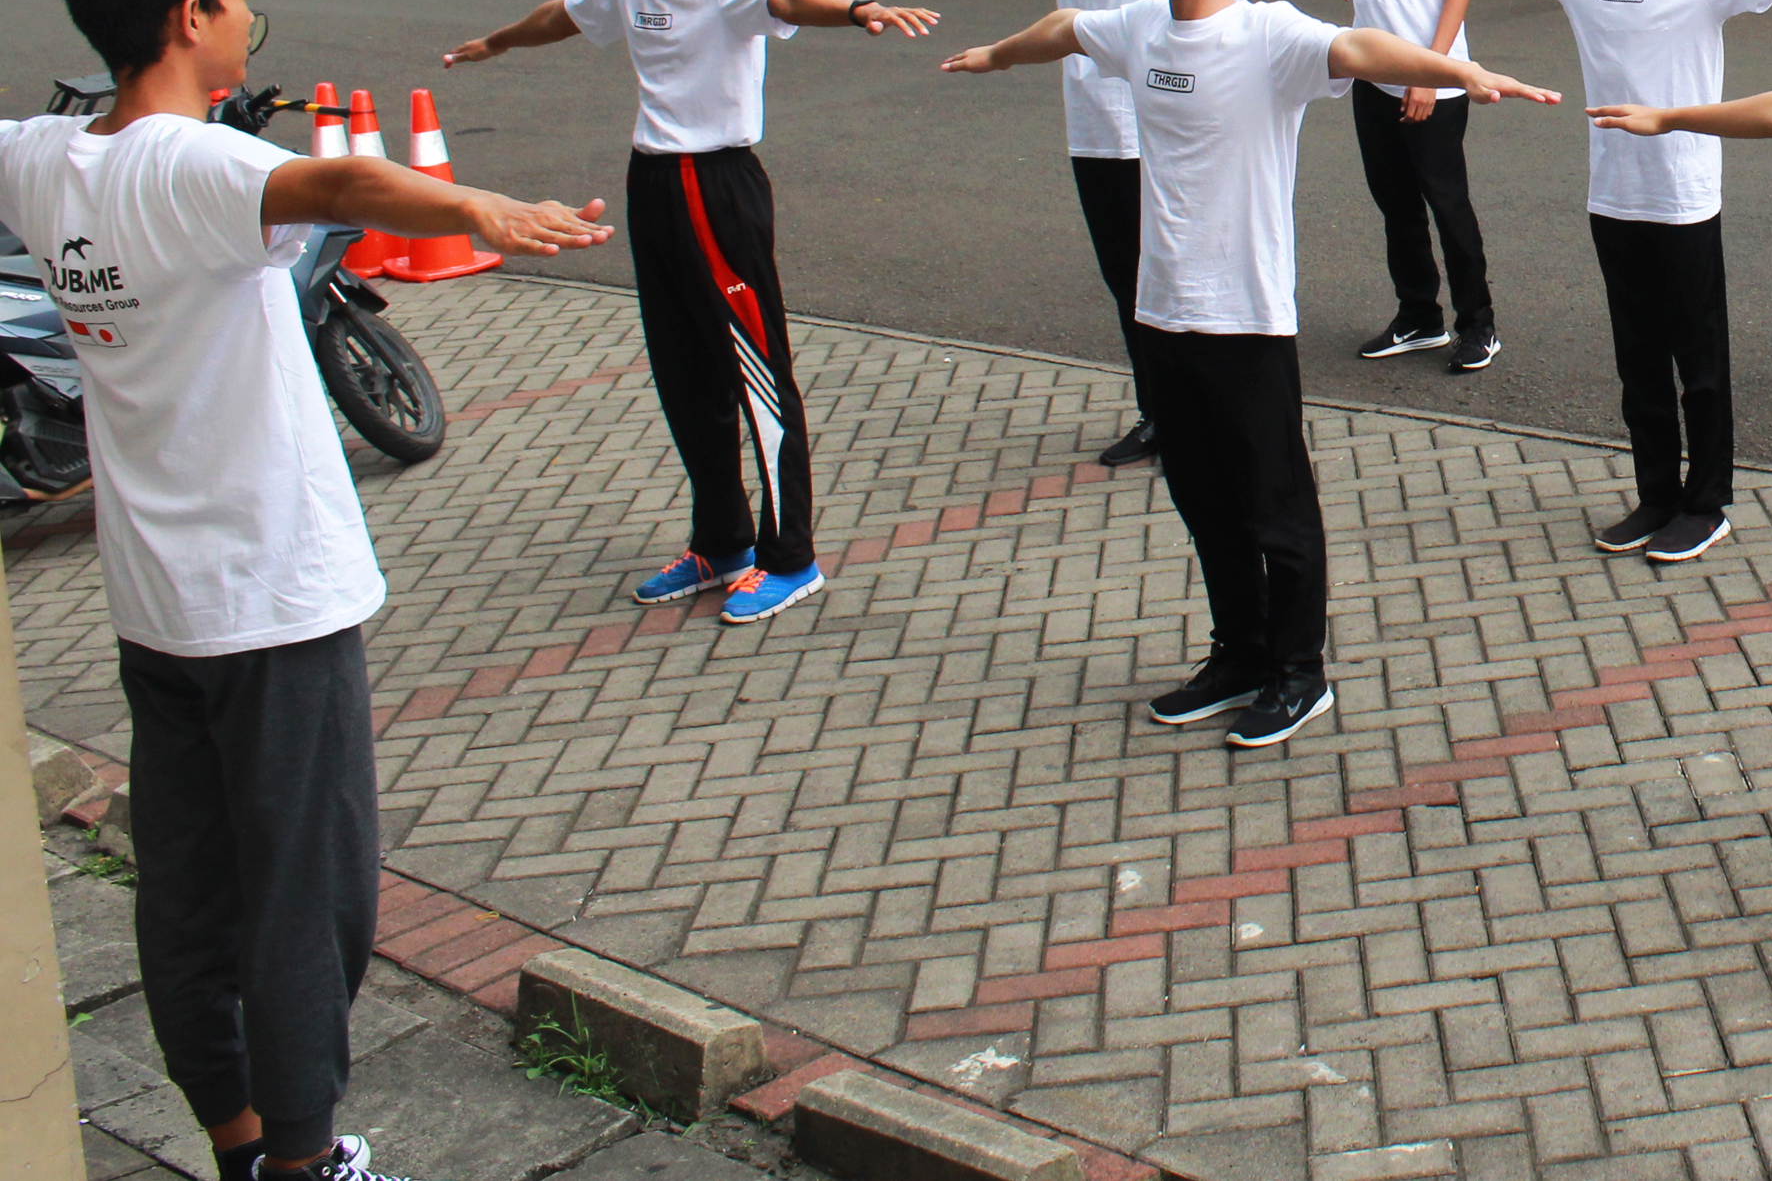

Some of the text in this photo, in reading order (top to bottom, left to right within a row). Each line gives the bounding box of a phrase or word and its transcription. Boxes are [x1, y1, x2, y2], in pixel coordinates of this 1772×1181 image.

[640, 14, 668, 27] THRGID
[1154, 73, 1190, 89] THRGID
[58, 296, 105, 313] Resources
[105, 297, 140, 310] Group
